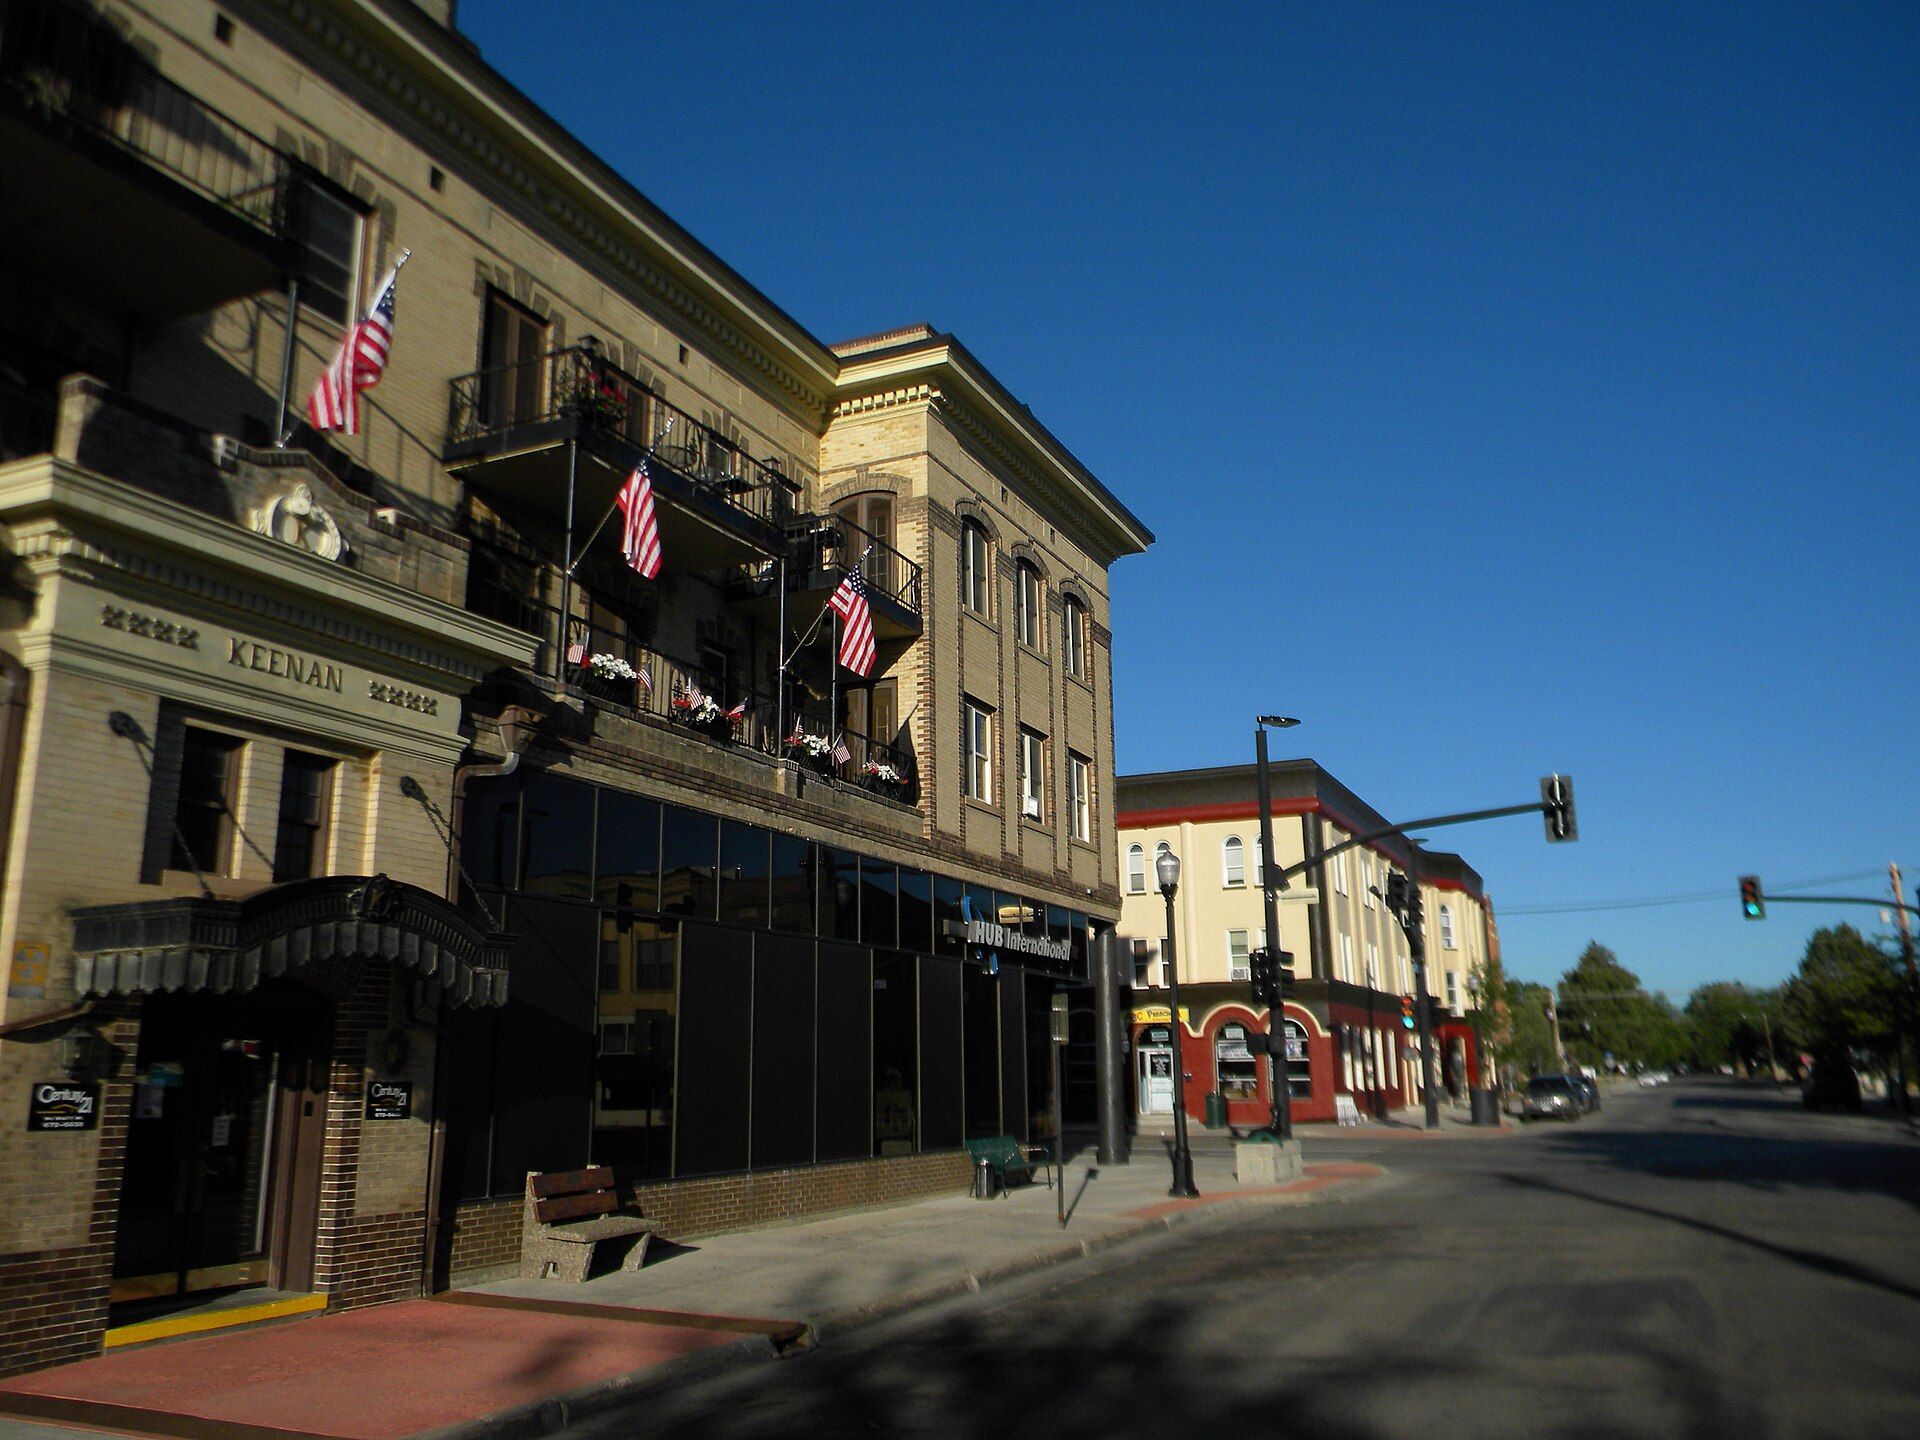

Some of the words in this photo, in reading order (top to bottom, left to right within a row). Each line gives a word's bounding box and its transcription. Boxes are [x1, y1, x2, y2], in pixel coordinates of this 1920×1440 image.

[227, 636, 344, 694] KEENAN
[974, 920, 1004, 947] HUB
[1006, 927, 1071, 961] International
[78, 1097, 93, 1113] 21
[397, 1092, 407, 1106] 21
